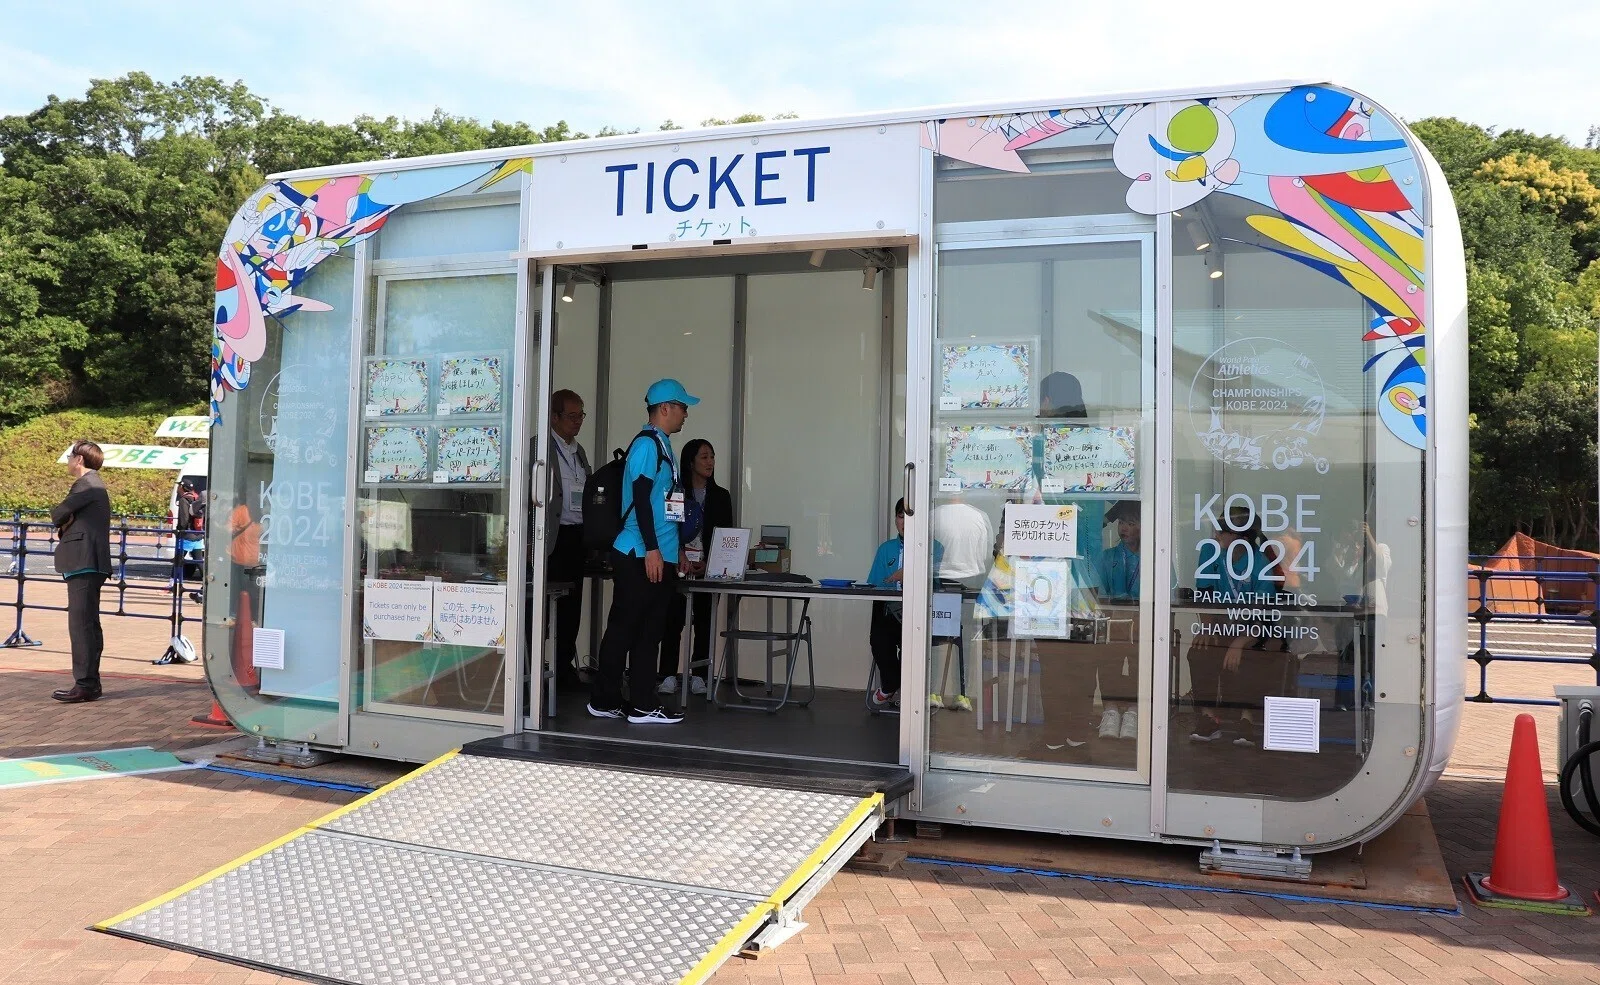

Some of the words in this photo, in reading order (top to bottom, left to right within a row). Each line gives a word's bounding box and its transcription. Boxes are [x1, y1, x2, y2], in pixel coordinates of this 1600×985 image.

[605, 146, 831, 216] TICKET
[676, 215, 751, 238] チケット
[1219, 356, 1241, 364] World
[1217, 364, 1270, 376] Athletics
[1212, 388, 1302, 398] CHAMPIONSHIPS
[1226, 400, 1257, 411] KOBE
[1259, 400, 1288, 411] 2024
[169, 420, 209, 433] WE
[103, 449, 163, 464] OBE
[260, 480, 332, 511] KOBE
[1194, 493, 1321, 533] KOBE
[259, 513, 330, 547] 2024
[1014, 519, 1069, 531] S席のチケット
[1011, 530, 1070, 542] 売り切れました
[1194, 538, 1321, 582] 2024
[1193, 590, 1233, 604] PARA
[1235, 591, 1318, 606] ATHLETICS
[369, 601, 390, 609] Tickets
[403, 603, 417, 611] only
[442, 602, 495, 613] この先、チケット
[373, 613, 405, 621] purchased
[440, 613, 499, 626] 販売はありません
[1227, 607, 1282, 622] WORLD
[1190, 623, 1319, 640] CHAMPIONSHIPS
